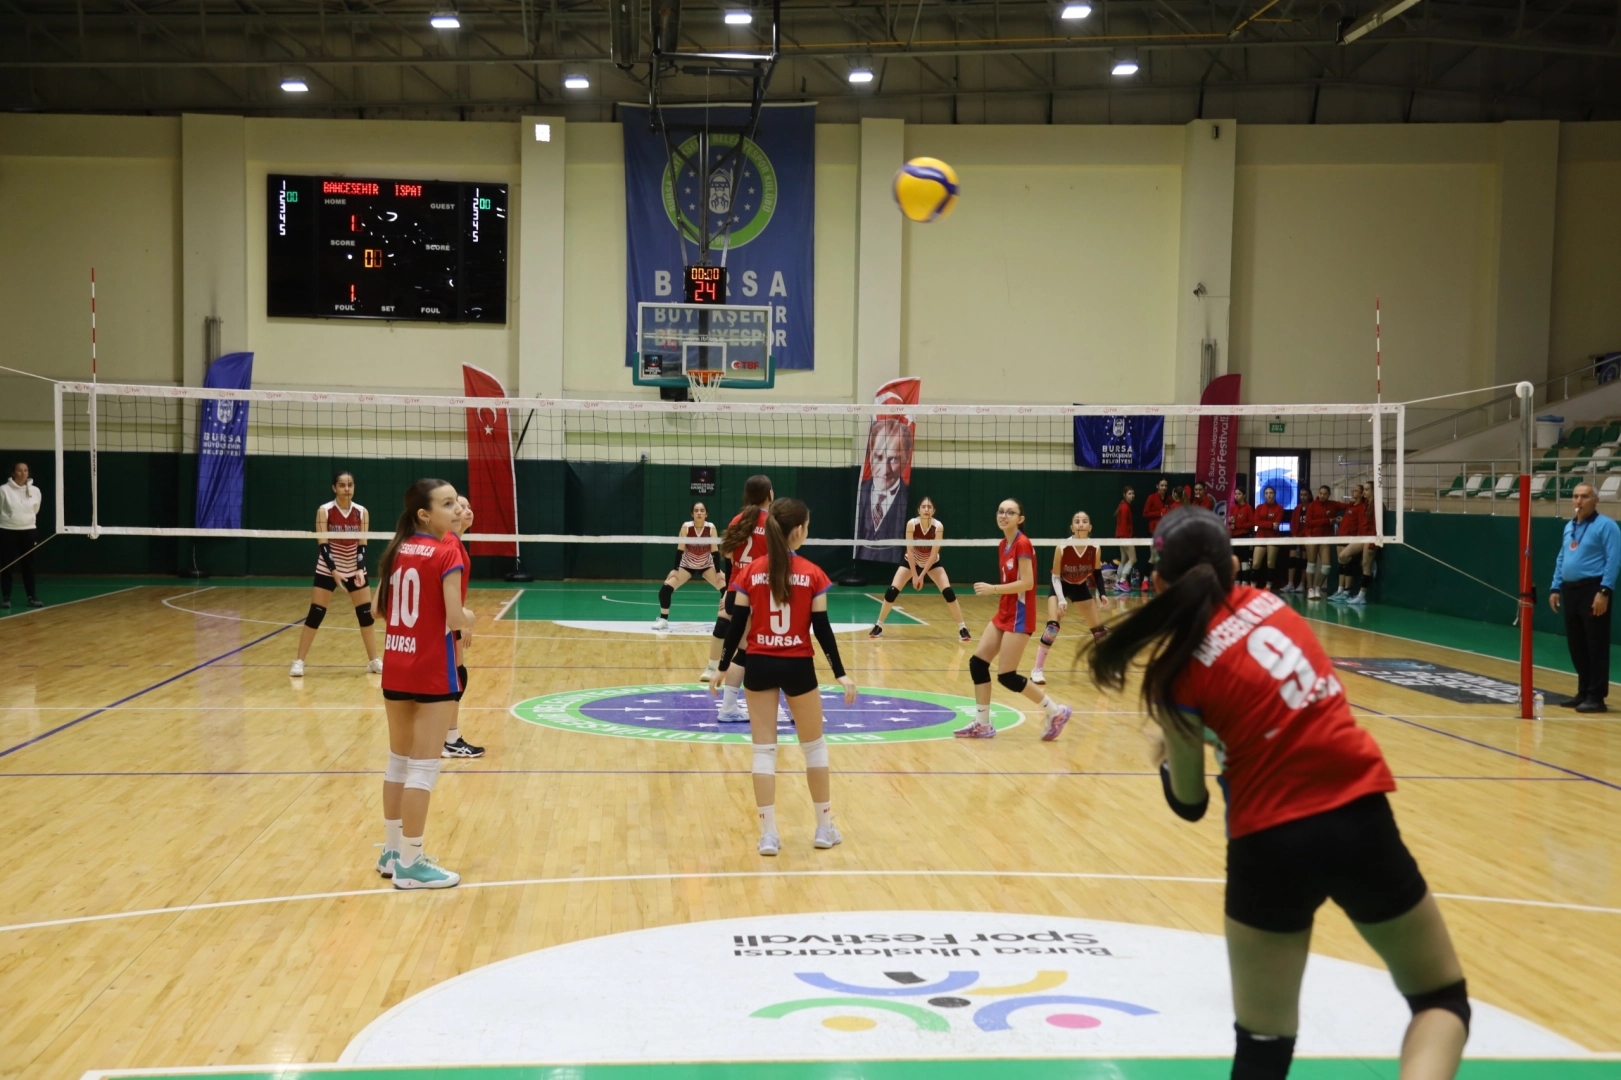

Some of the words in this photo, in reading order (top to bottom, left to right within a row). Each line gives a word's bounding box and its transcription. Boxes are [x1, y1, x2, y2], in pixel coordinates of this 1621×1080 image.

[324, 182, 379, 195] BAHCESEHIR
[694, 281, 716, 302] 24
[741, 361, 759, 370] TBF
[204, 432, 241, 443] BURSA
[1216, 464, 1228, 491] Spor
[739, 536, 753, 563] 2
[390, 565, 420, 628] 10
[770, 590, 791, 635] 5
[385, 634, 416, 654] BURSA
[757, 634, 803, 646] BURSA
[1247, 625, 1317, 710] 9
[734, 934, 958, 946] Festivali
[970, 931, 1099, 944] Spor
[993, 947, 1112, 956] Bursa
